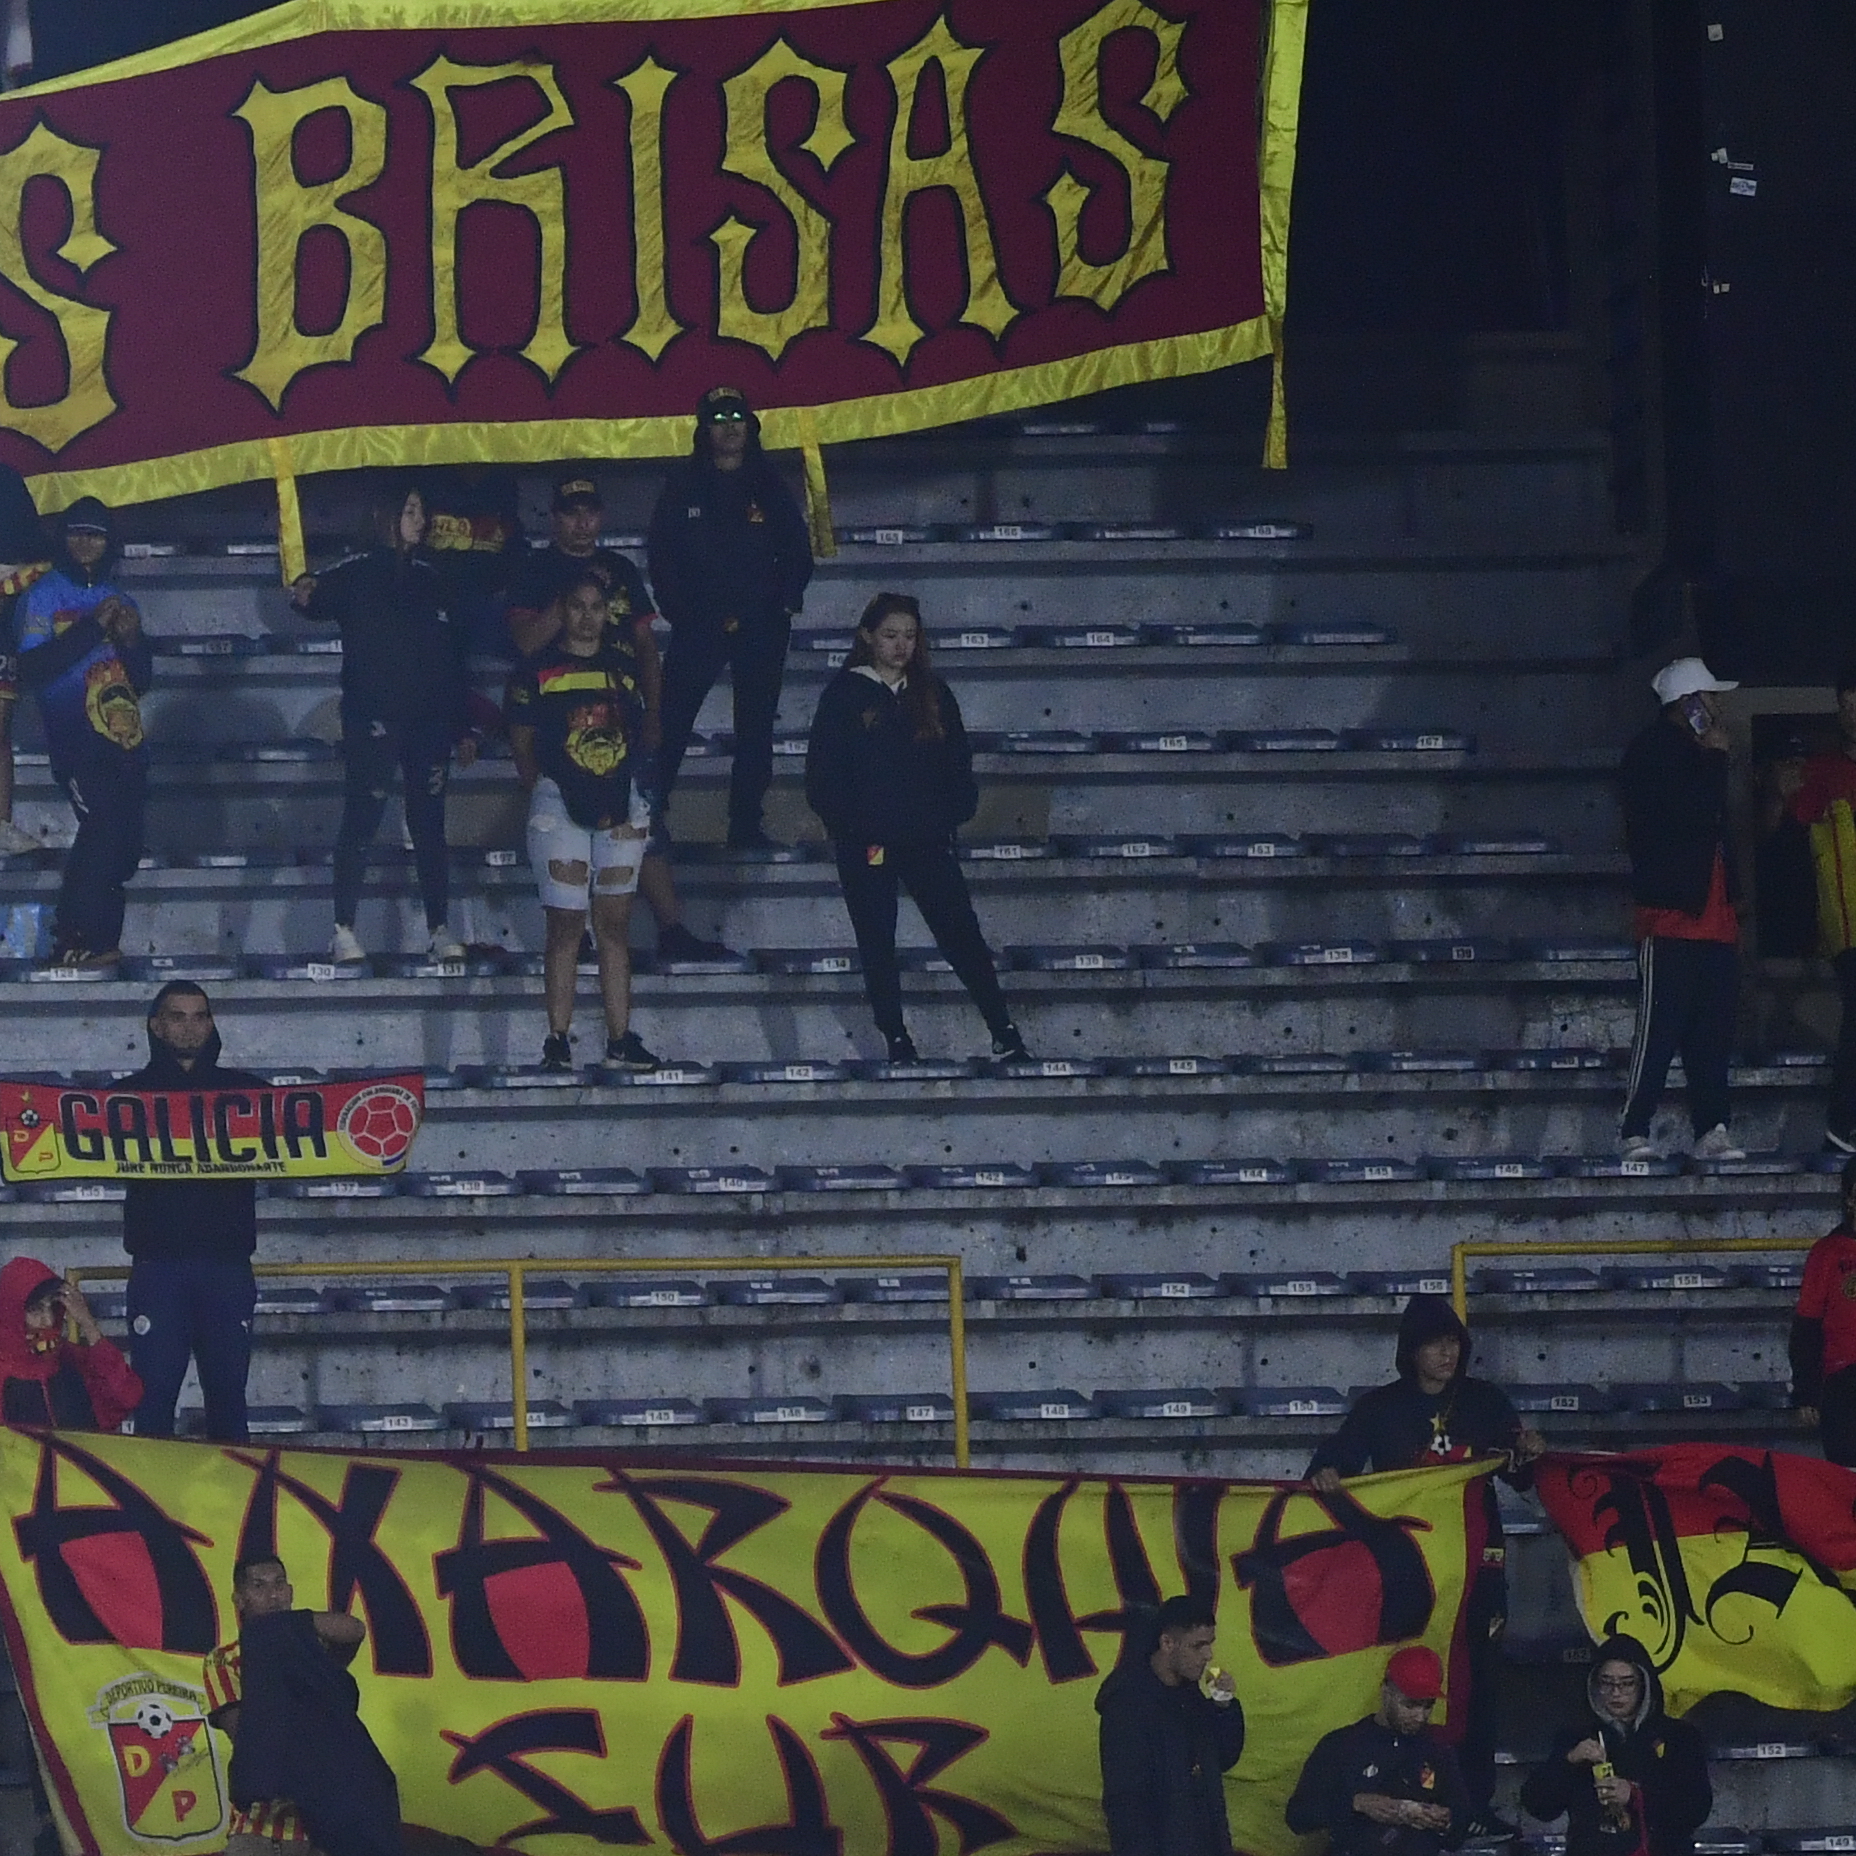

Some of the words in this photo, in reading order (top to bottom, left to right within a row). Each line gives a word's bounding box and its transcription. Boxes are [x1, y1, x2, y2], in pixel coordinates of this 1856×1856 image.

[228, 0, 1192, 410] BRISAS
[964, 634, 985, 645] 163
[1419, 736, 1441, 747] 167
[789, 1067, 810, 1078] 142
[1045, 1064, 1067, 1073] 144
[658, 1071, 679, 1081] 141
[57, 1090, 329, 1163] GALICIA
[1624, 1162, 1647, 1173] 147
[1242, 1170, 1263, 1179] 144
[1165, 1284, 1186, 1295] 154
[908, 1407, 931, 1418] 147
